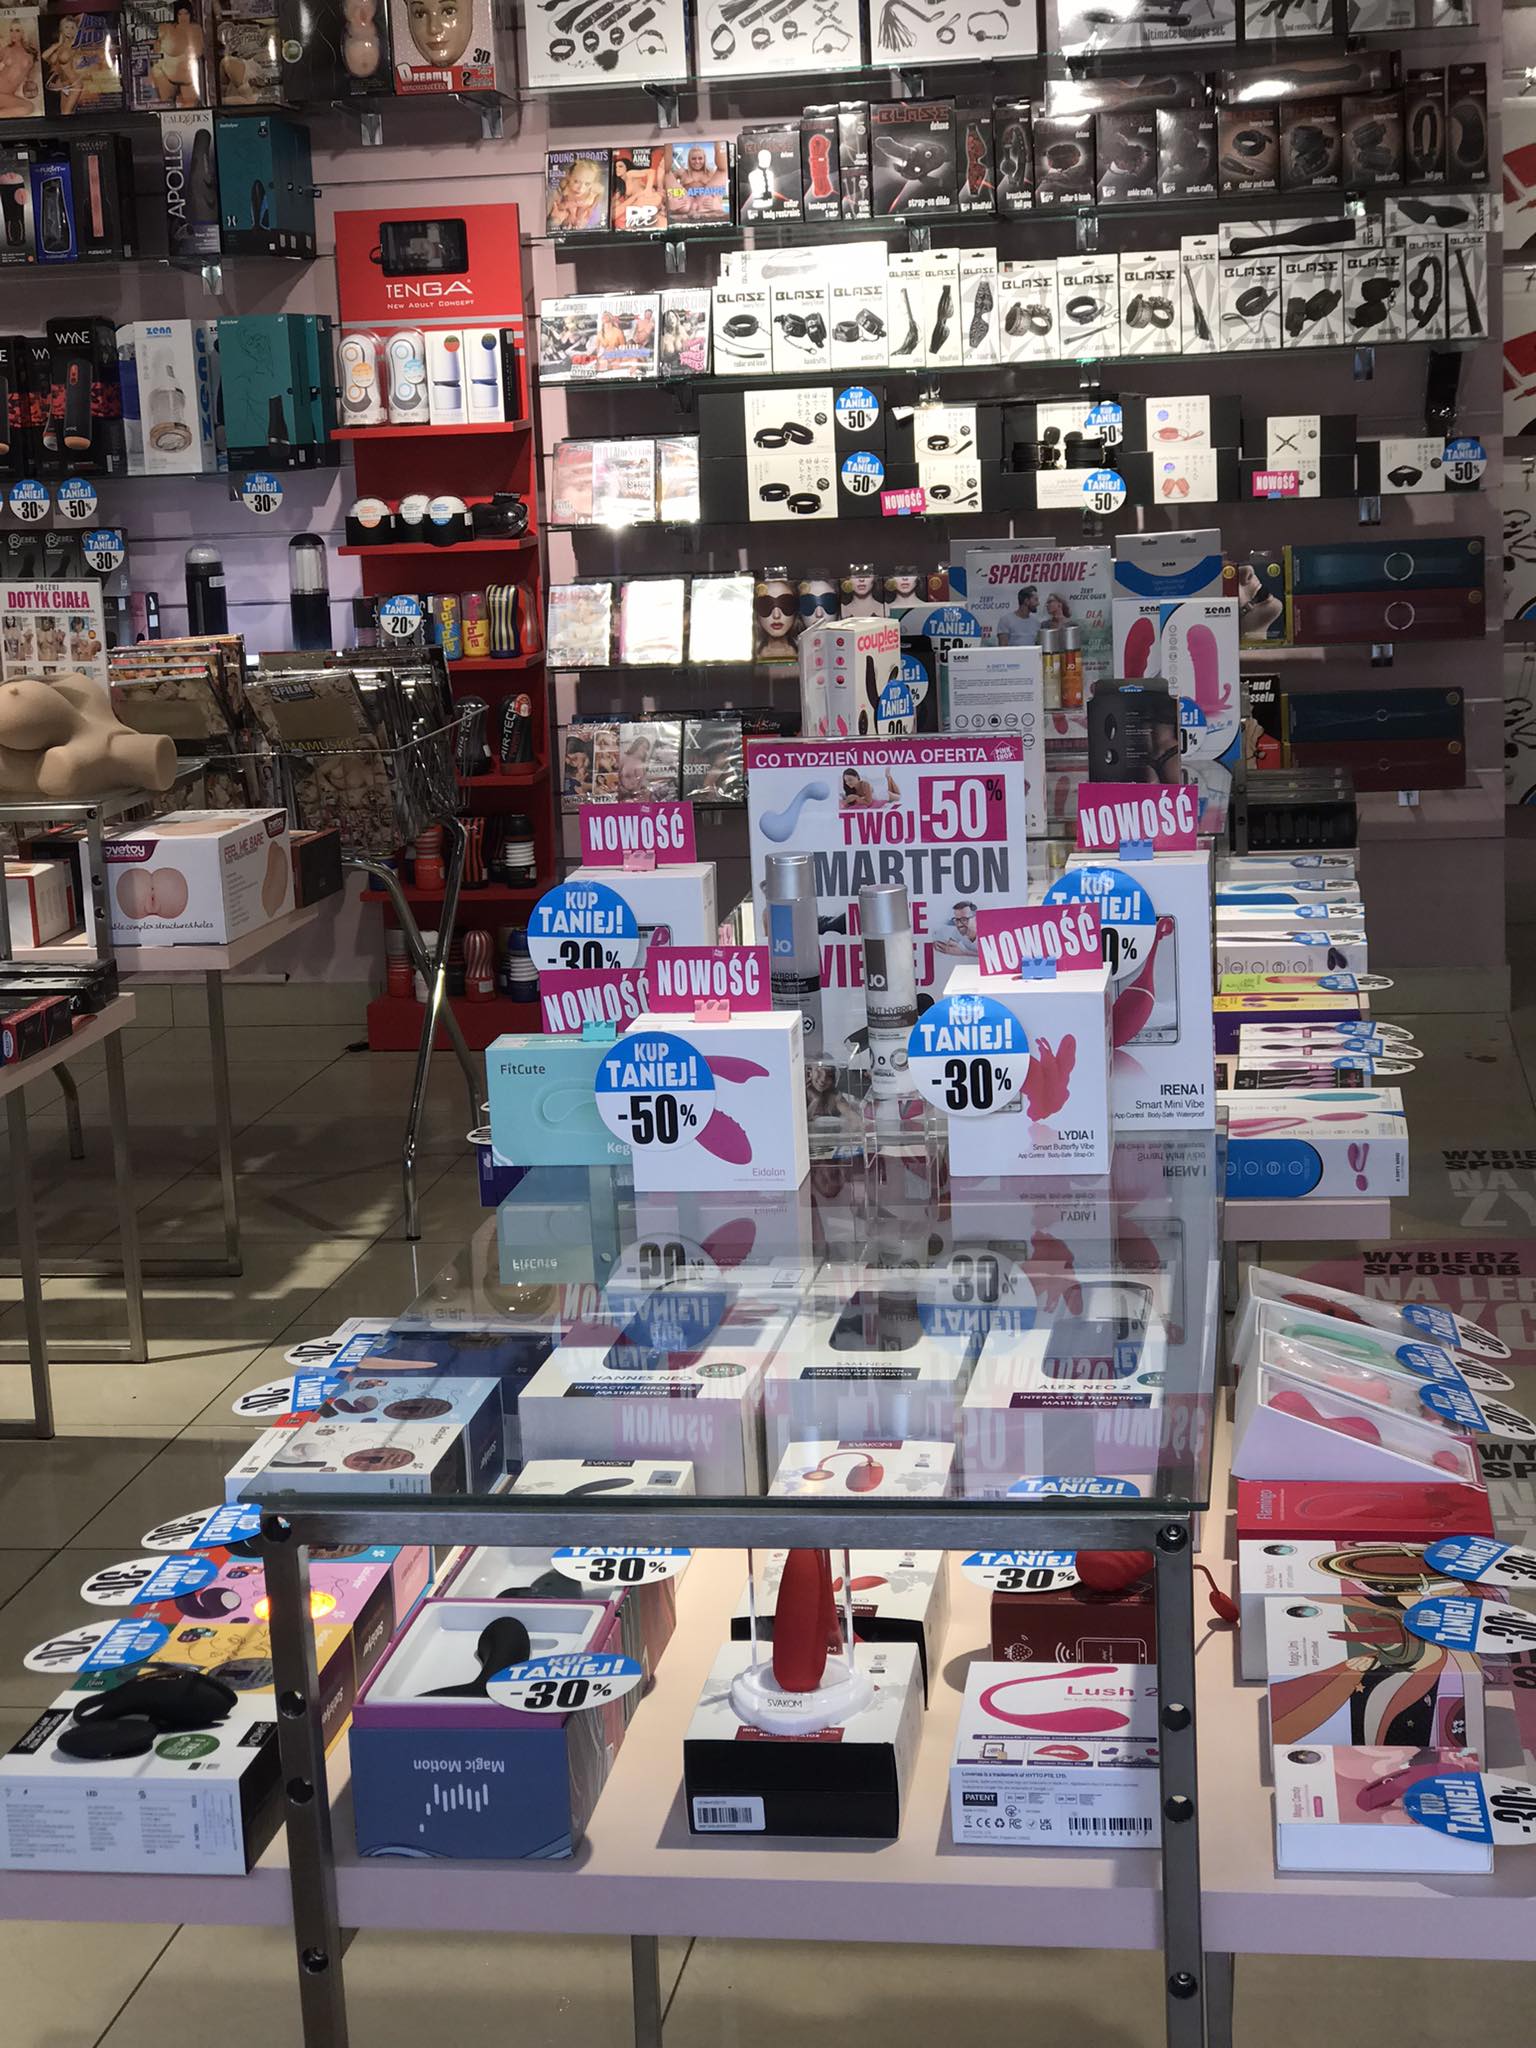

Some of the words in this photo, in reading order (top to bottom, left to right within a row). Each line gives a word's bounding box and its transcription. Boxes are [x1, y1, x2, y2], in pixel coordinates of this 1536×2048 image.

[550, 154, 574, 163] YOUNG
[633, 154, 650, 163] ANAL
[164, 131, 187, 220] APOLLO
[1183, 253, 1216, 262] BLASE
[1347, 256, 1400, 269] BLASE
[889, 270, 921, 278] BLASE
[925, 269, 957, 278] BLASE
[963, 267, 995, 275] BLASE
[1125, 270, 1176, 281] BLASE
[1224, 265, 1276, 278] BLASE
[1286, 261, 1338, 274] BLASE
[1002, 278, 1053, 290] BLASE
[1064, 273, 1114, 286] BLASE
[386, 282, 473, 299] TENGA
[717, 293, 766, 303] BLASE
[775, 289, 825, 301] BLASE
[834, 286, 883, 297] BLASE
[146, 326, 172, 335] zenn
[840, 396, 872, 408] TANIEJ!
[844, 410, 872, 428] -50%
[1447, 446, 1481, 460] TANIEJ!
[847, 461, 879, 474] TANIEJ!
[1450, 461, 1480, 482] -50%
[60, 487, 91, 498] TANIEJ!
[247, 481, 277, 493] TANIEJ!
[849, 474, 877, 493] -50%
[1088, 479, 1120, 490] TANIEJ!
[1256, 475, 1296, 492] NOWOŚĆ
[13, 488, 44, 500] TANIEJ!
[249, 493, 279, 513] -30%
[884, 489, 923, 511] NOWOŚĆ
[1091, 492, 1119, 512] -50%
[16, 500, 44, 519] -30%
[65, 499, 92, 518] -50%
[89, 539, 119, 550] TANIEJ!
[91, 550, 119, 569] -30%
[1010, 552, 1065, 563] WIBRATORY
[988, 561, 1088, 585] SPACEROWE
[8, 591, 51, 608] DOTYK
[53, 590, 91, 608] CIAŁA
[385, 603, 417, 615] TANIEJ!
[943, 611, 962, 622] KUP
[1204, 606, 1231, 615] zenn
[387, 616, 414, 635] -20%
[929, 619, 975, 636] TANIEJ!
[857, 626, 899, 654] couples
[756, 753, 781, 768] CO
[784, 747, 859, 767] TYDZIEŃ
[863, 750, 917, 765] NOWA
[922, 748, 988, 763] OFERTA
[922, 778, 1003, 840] -50%
[1080, 786, 1194, 847] NOWOŚĆ
[588, 807, 685, 850] NOWOŚĆ
[838, 804, 916, 845] TWÓJ
[812, 846, 1010, 897] MARTFON
[1080, 877, 1115, 895] KUP
[564, 891, 599, 909] KUP
[538, 905, 624, 935] TANIEJ!
[773, 941, 792, 954] JO
[980, 905, 1098, 974] NOWOŚĆ
[547, 940, 621, 970] -30%
[657, 952, 760, 997] NOWOŚĆ
[868, 974, 885, 987] JO
[543, 970, 650, 1033] NOWOŚĆ
[949, 1006, 985, 1024] KUP
[920, 1018, 1013, 1053] TANIEJ!
[633, 1043, 669, 1061] KUP
[501, 1064, 546, 1075] FitCute
[606, 1055, 697, 1088] TANIEJ!
[931, 1057, 1012, 1110] -30%
[1160, 1083, 1198, 1096] IRENA
[1135, 1100, 1163, 1110] Smart
[1164, 1100, 1182, 1109] Mini
[1183, 1099, 1205, 1108] Vibe
[617, 1092, 698, 1145] -50%
[1058, 1130, 1089, 1142] LYDIA
[1032, 1143, 1053, 1152] Smart
[1053, 1142, 1080, 1152] Butterfly
[1080, 1142, 1095, 1151] Vibe
[752, 1167, 786, 1177] Eidolon
[1363, 1251, 1521, 1264] WYBIERZ
[1363, 1264, 1521, 1276] SPOSOB
[1364, 1277, 1441, 1300] NA
[1421, 1305, 1457, 1340] TANIEJ!
[1458, 1323, 1507, 1355] -30%
[289, 1340, 344, 1363] -20%
[1412, 1345, 1461, 1381] TANIEJ!
[1454, 1358, 1511, 1386] -30%
[239, 1386, 291, 1414] -20%
[296, 1376, 326, 1408] TANIEJ!
[1438, 1385, 1483, 1426] TANIEJ!
[1480, 1401, 1536, 1436] -30%
[1023, 1480, 1126, 1495] TANIEJ!
[1055, 1476, 1097, 1485] KUP
[1257, 1489, 1274, 1521] Flamingo
[145, 1514, 208, 1546] -30%
[199, 1503, 251, 1542] TANIEJ!
[1435, 1543, 1465, 1559] KUP
[1445, 1535, 1510, 1575] TANIEJ!
[141, 1557, 200, 1597] TANIEJ!
[181, 1568, 209, 1585] KUP
[575, 1557, 667, 1583] -30%
[982, 1567, 1077, 1590] -30%
[85, 1564, 153, 1601] -30%
[1416, 1609, 1443, 1626] KUP
[1435, 1598, 1477, 1642] TANIEJ!
[32, 1631, 102, 1668] -20%
[89, 1619, 153, 1666] TANIEJ!
[132, 1632, 161, 1651] KUP
[509, 1658, 625, 1681] TANIEJ!
[548, 1654, 594, 1668] KUP
[510, 1678, 612, 1710] -30%
[1066, 1685, 1135, 1697] Lush
[1144, 1687, 1159, 1697] 2
[767, 1698, 803, 1709] SVAKOM
[412, 1757, 463, 1772] Motion
[464, 1758, 506, 1774] Magic
[965, 1793, 995, 1802] PATENT
[1419, 1792, 1447, 1815] KUP
[1434, 1778, 1486, 1835] TANIEJ!
[1489, 1784, 1536, 1834] -30%
